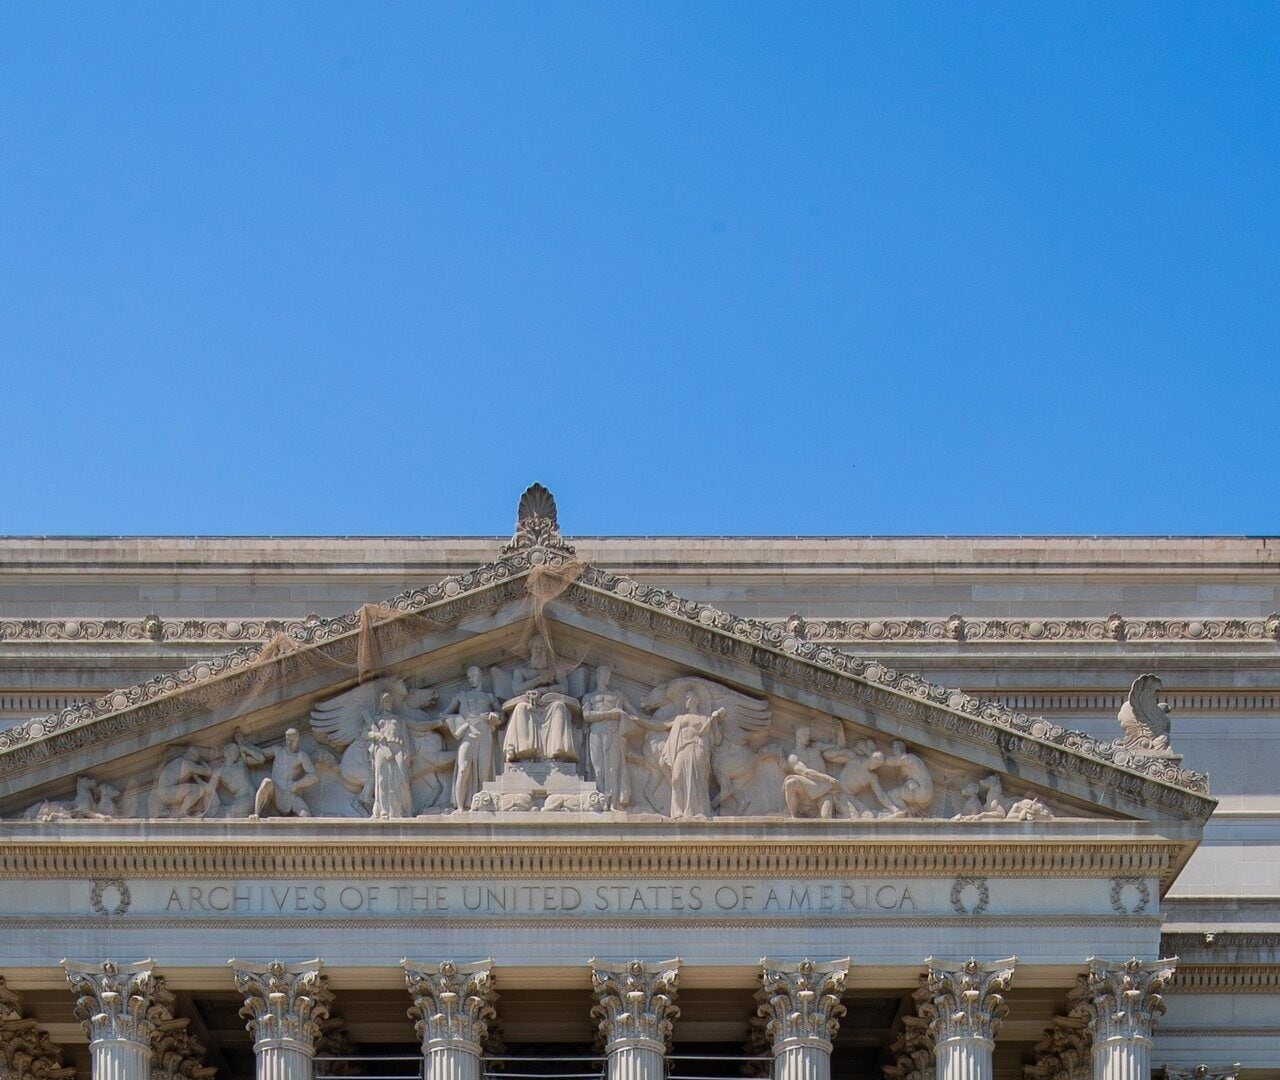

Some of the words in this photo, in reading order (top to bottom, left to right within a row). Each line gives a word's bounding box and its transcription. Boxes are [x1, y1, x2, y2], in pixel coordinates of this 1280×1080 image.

[165, 885, 327, 912] ARCHIVES
[338, 885, 380, 912] OF
[389, 885, 451, 911] THE
[462, 885, 582, 912] UNITED
[594, 885, 704, 911] STATES
[714, 885, 755, 911] OF
[763, 884, 917, 911] AMERICA
